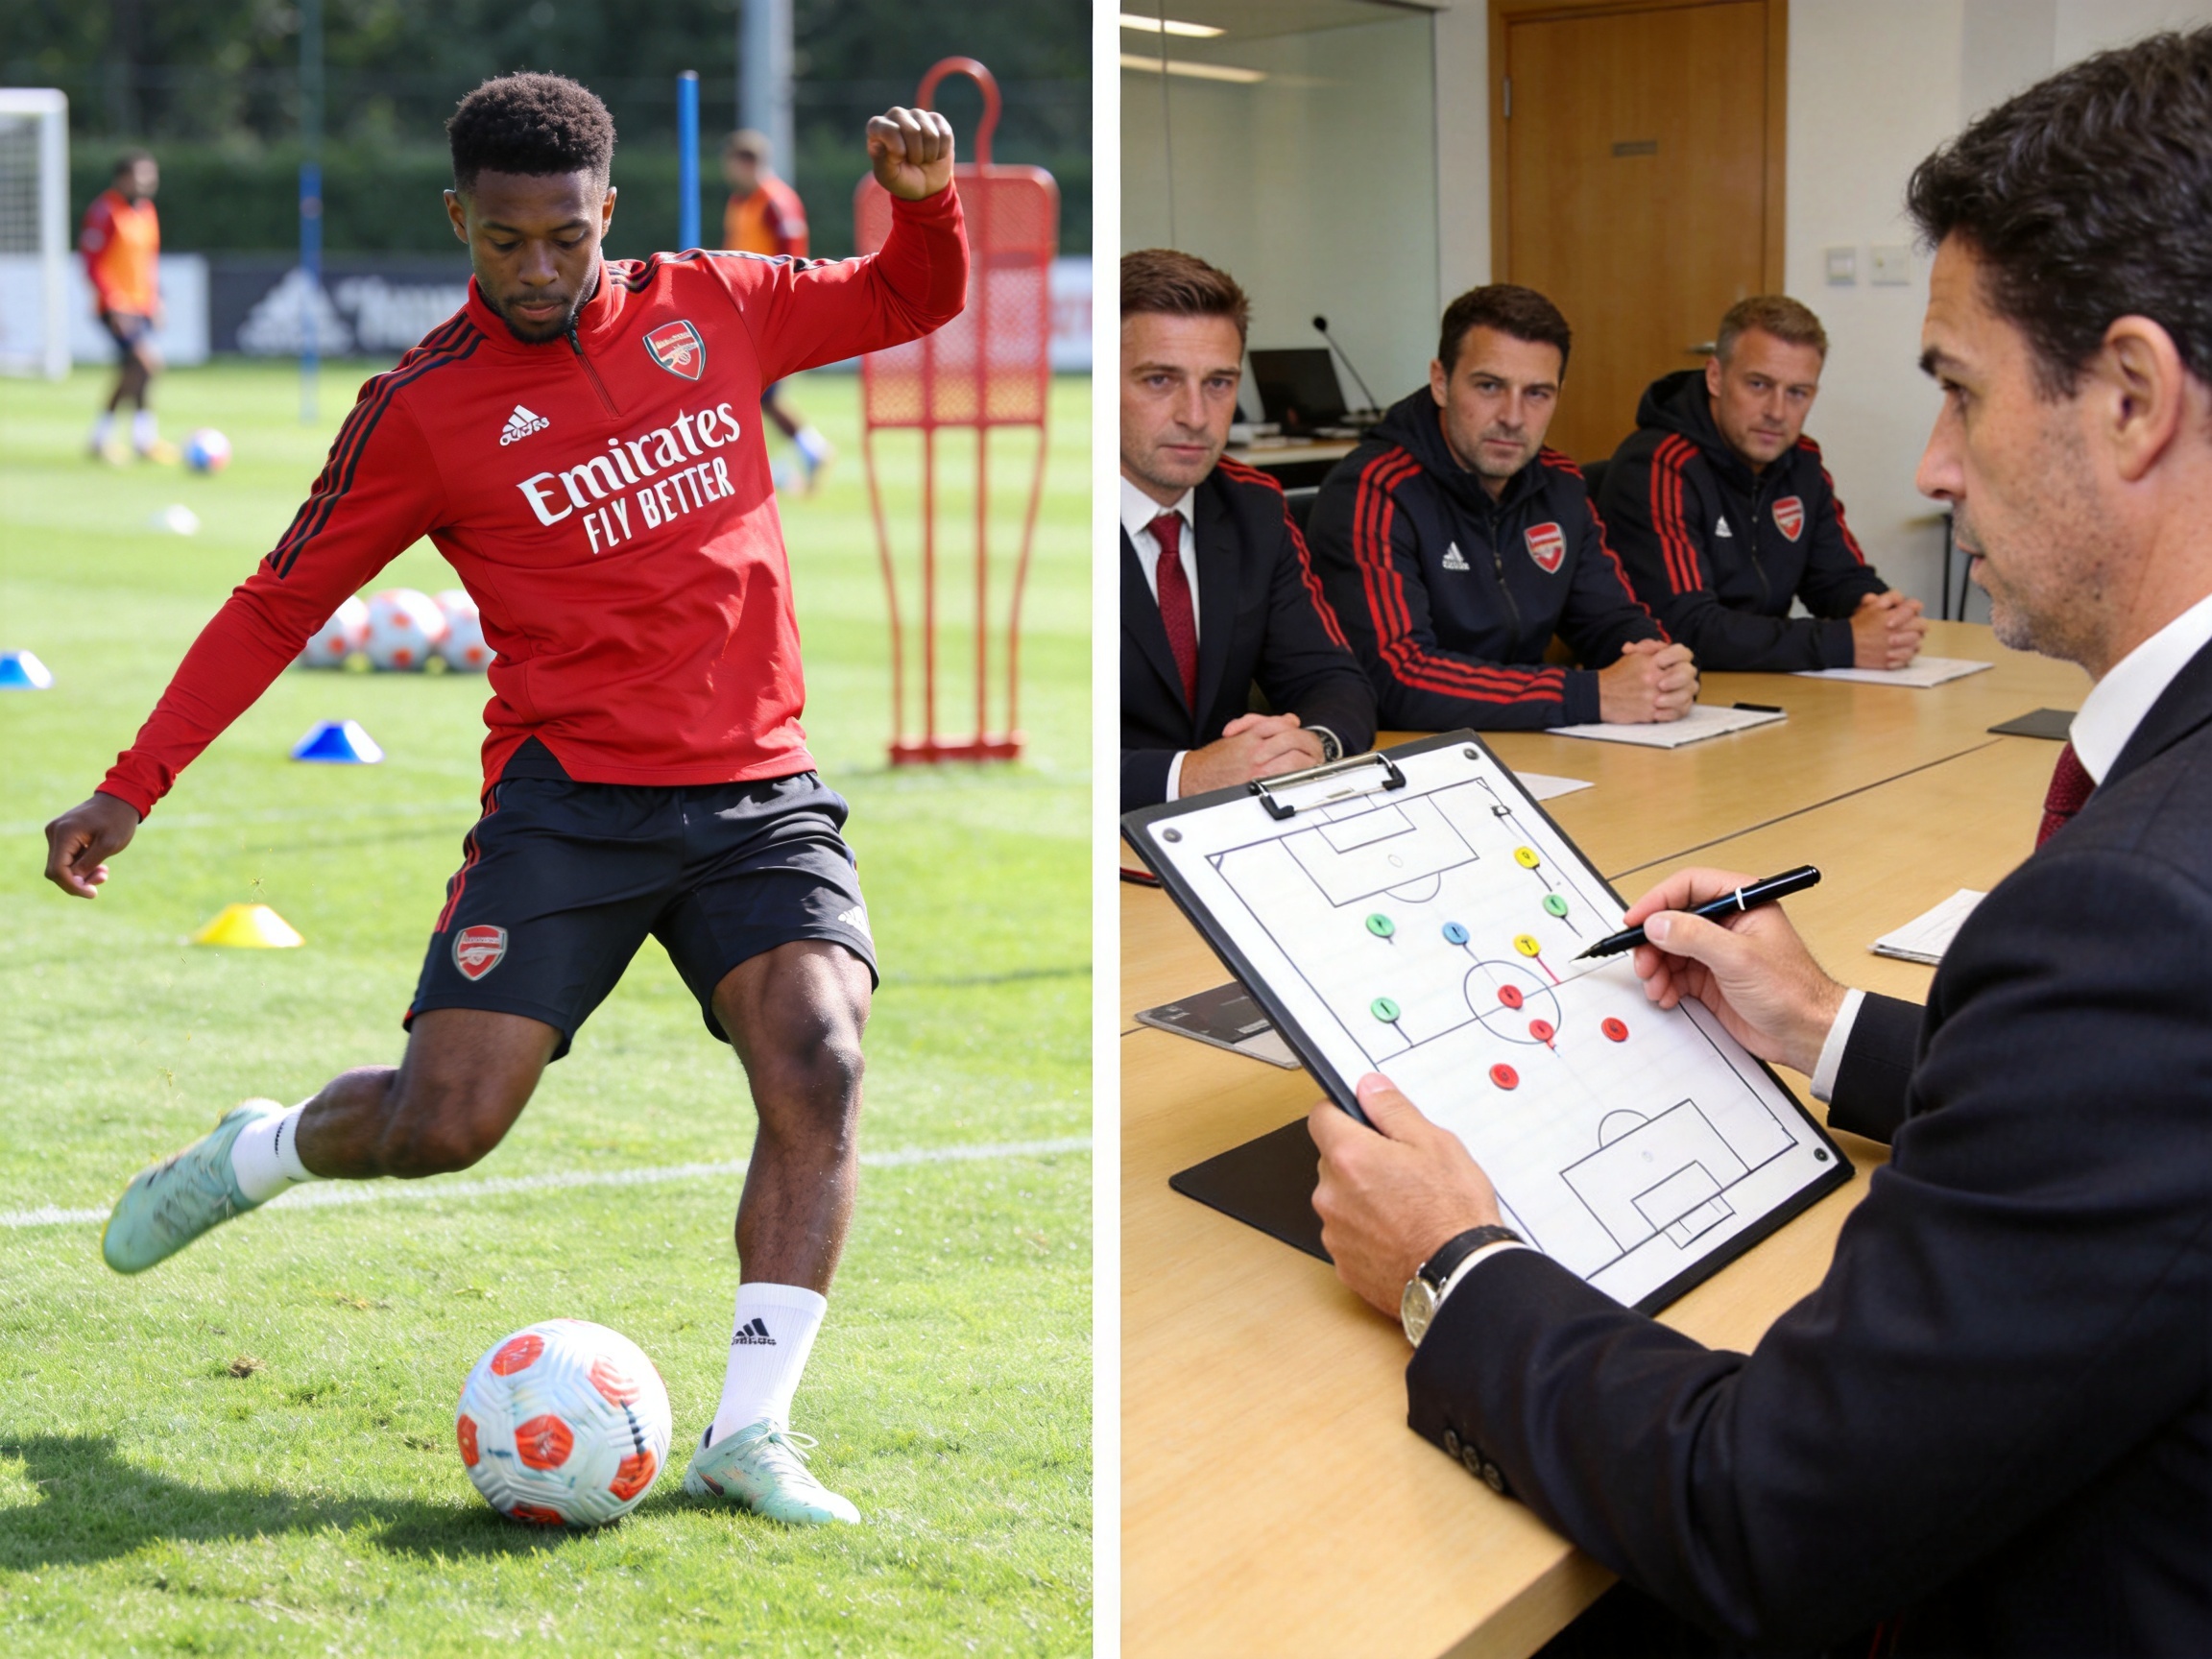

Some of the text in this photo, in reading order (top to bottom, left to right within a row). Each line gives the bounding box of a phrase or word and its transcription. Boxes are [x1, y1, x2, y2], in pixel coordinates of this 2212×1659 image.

[516, 402, 740, 526] Emirates
[583, 456, 735, 554] FLY BETTER
